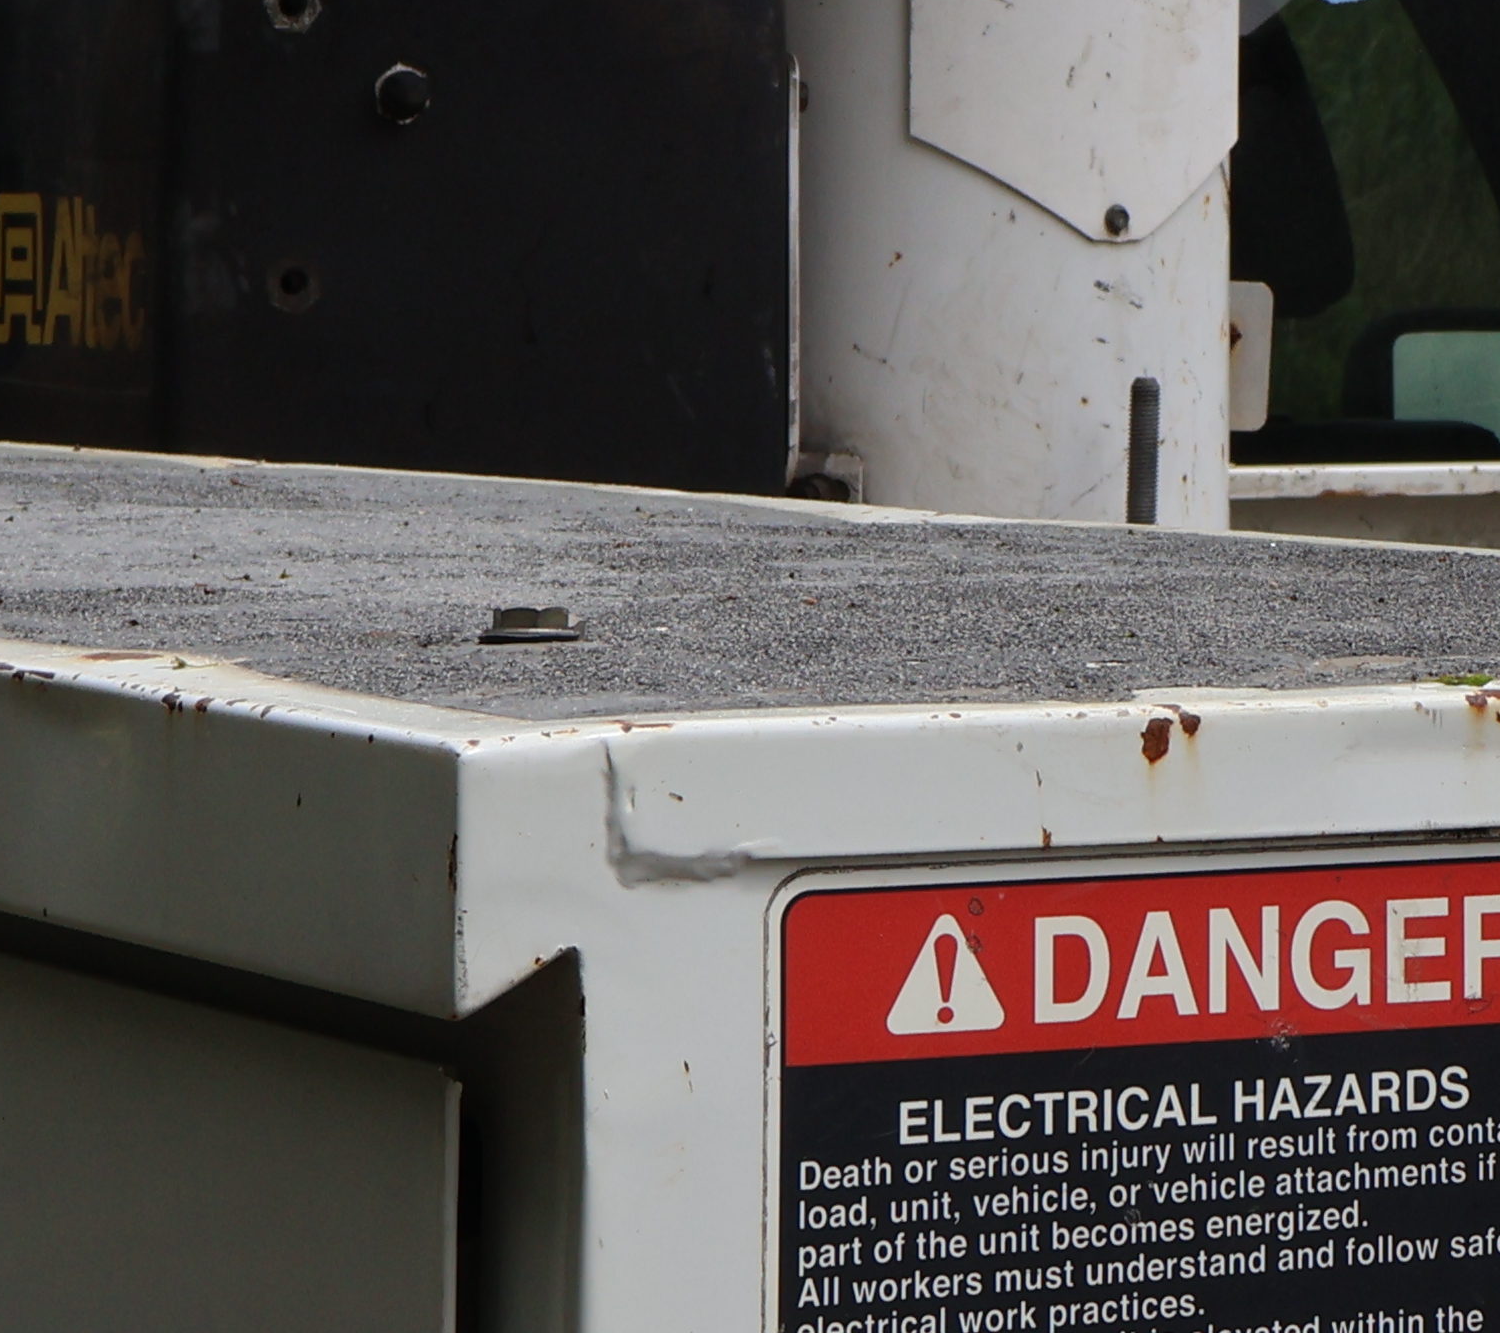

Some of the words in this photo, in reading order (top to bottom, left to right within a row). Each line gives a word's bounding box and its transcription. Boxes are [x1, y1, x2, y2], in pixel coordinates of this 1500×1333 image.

[41, 194, 145, 352] Altec
[899, 1083, 1218, 1145] ELECTRICAL
[1234, 1065, 1470, 1123] HAZARDS
[799, 1156, 892, 1191] Death
[904, 1159, 938, 1184] or
[949, 1147, 1069, 1181] serious
[1081, 1141, 1171, 1177] injury
[1182, 1132, 1235, 1164] will
[1248, 1126, 1336, 1160] result
[1346, 1124, 1417, 1153] from
[799, 1196, 877, 1230] load,
[890, 1190, 960, 1224] unit,
[973, 1182, 1096, 1217] vehicle,
[1109, 1183, 1142, 1208] or
[1152, 1169, 1266, 1204] vehicle
[1275, 1157, 1467, 1196] attachments
[1478, 1152, 1496, 1182] if
[797, 1276, 840, 1308] All
[852, 1270, 983, 1304] workers
[995, 1260, 1074, 1293] must
[1086, 1244, 1266, 1286] understand
[1278, 1239, 1334, 1272] and
[1345, 1234, 1439, 1266] follow
[798, 1237, 862, 1277] part
[873, 1231, 905, 1264] of
[916, 1230, 968, 1260] the
[979, 1223, 1040, 1256] unit
[1052, 1218, 1195, 1250] becomes
[1206, 1199, 1369, 1241] energized.
[958, 1300, 1037, 1333] work
[1049, 1293, 1205, 1333] practices.
[1435, 1305, 1484, 1333] the
